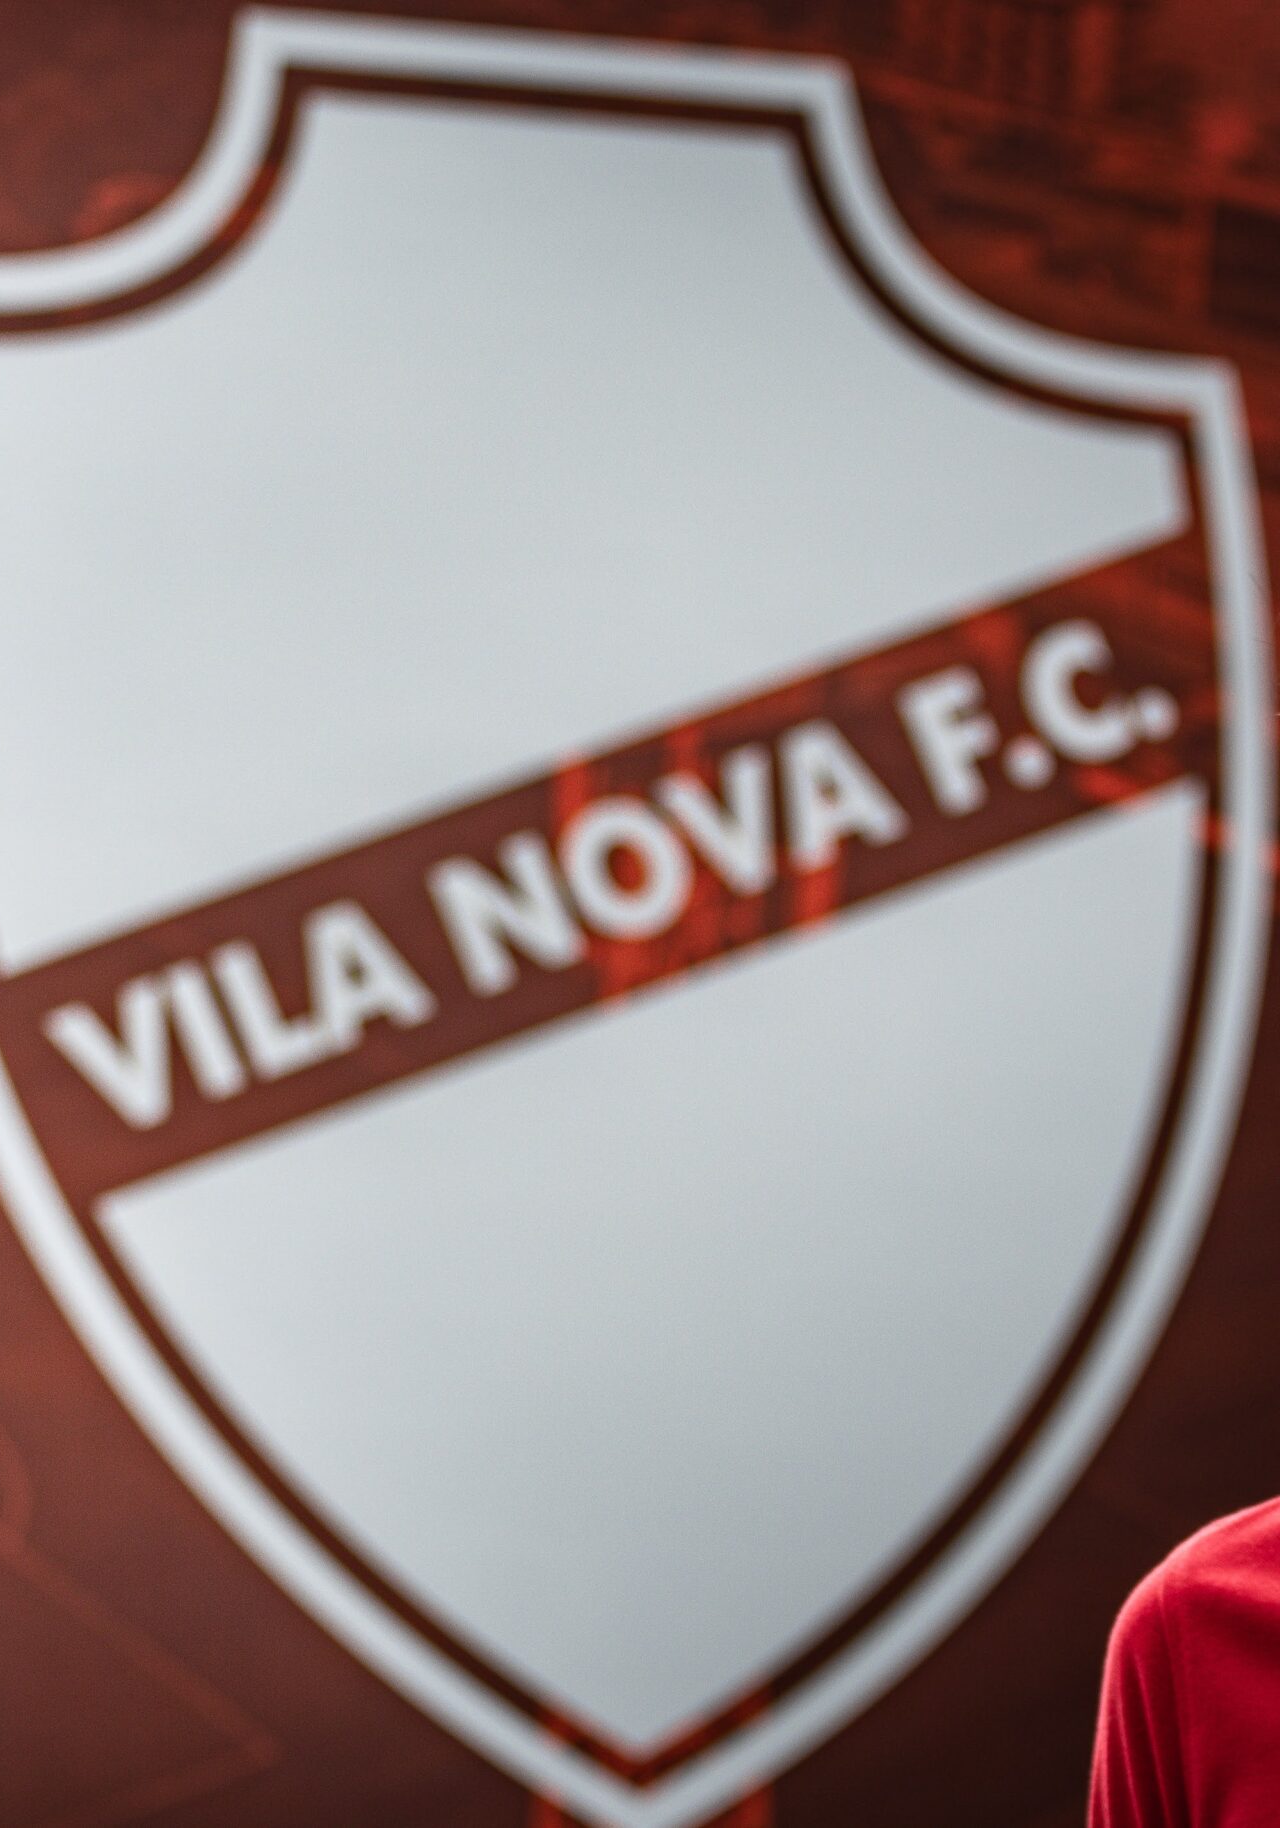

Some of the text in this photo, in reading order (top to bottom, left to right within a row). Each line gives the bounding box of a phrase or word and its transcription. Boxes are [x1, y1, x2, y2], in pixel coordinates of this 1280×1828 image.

[44, 620, 1181, 1130] VILA NOVA F.C.
